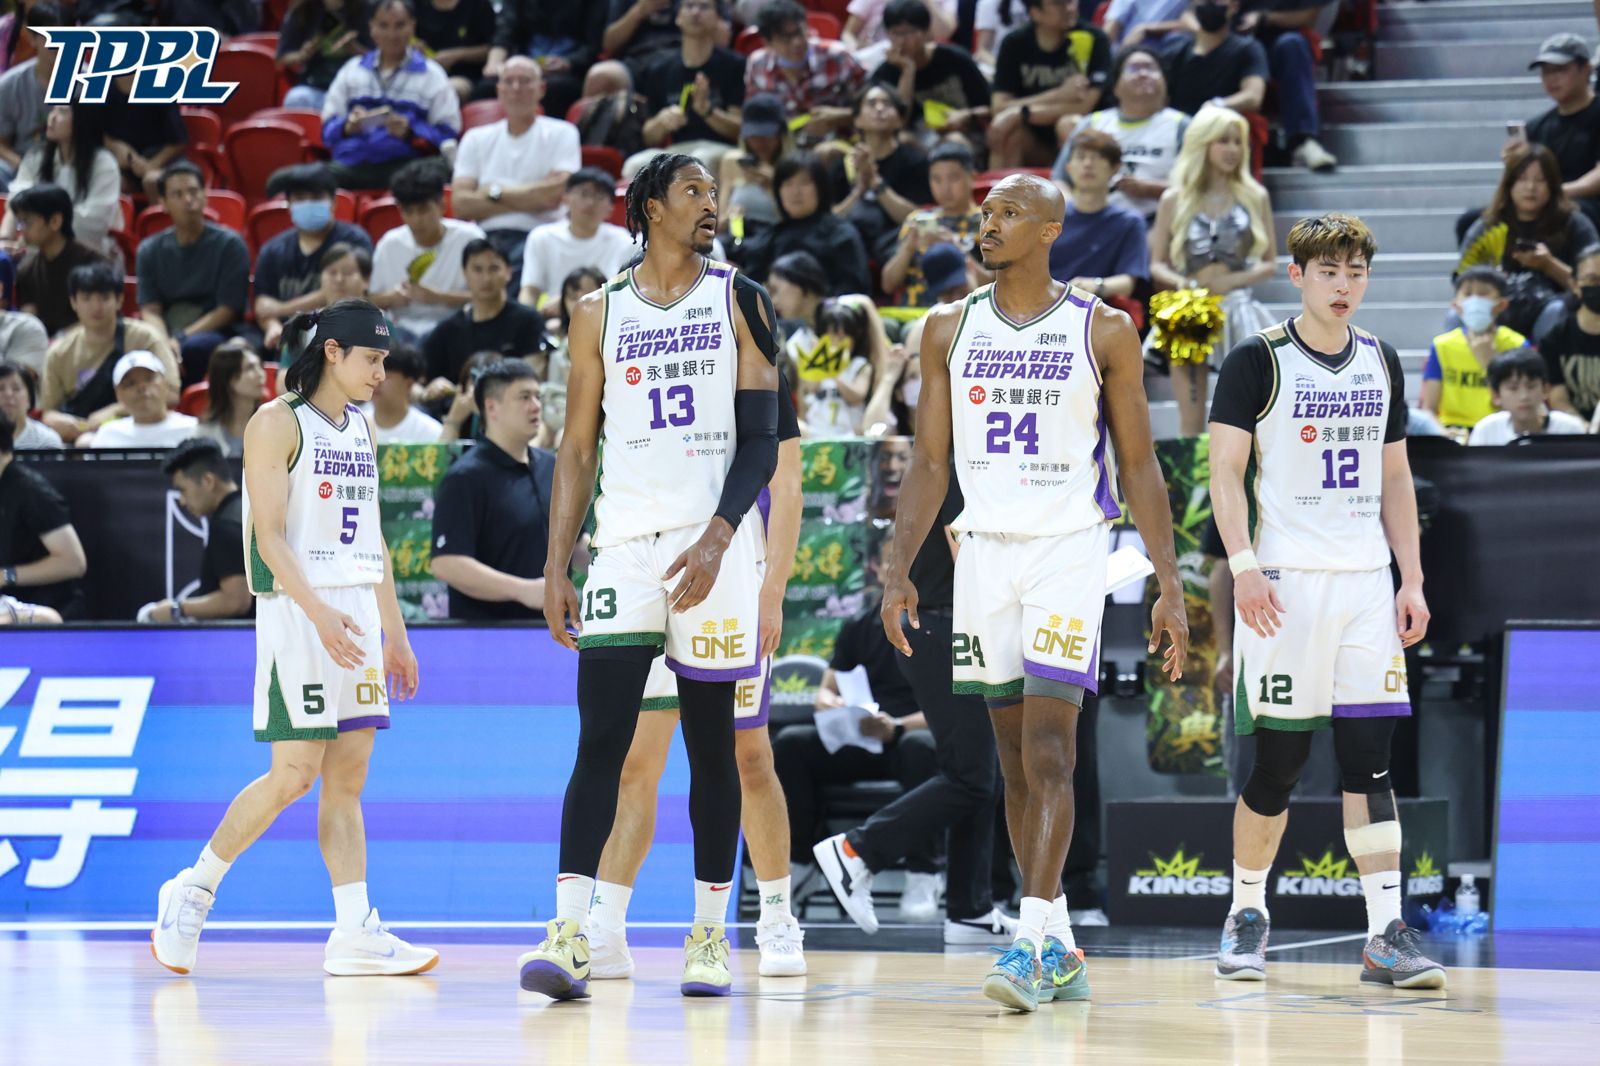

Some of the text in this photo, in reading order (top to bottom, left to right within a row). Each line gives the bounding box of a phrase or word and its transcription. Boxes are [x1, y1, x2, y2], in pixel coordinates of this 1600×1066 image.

[618, 321, 721, 345] TAIWAN BEER
[616, 334, 722, 363] LEOPARDS
[967, 350, 1074, 363] TAIWAN BEER
[647, 360, 716, 381] 永豐銀行
[962, 363, 1072, 381] LEOPARDS
[648, 384, 696, 430] 13
[992, 388, 1061, 406] 永豐銀行
[1295, 390, 1383, 402] TAIWAN BEER
[1292, 402, 1384, 418] LEOPARDS
[986, 411, 1039, 455] 24
[1321, 426, 1379, 442] 永豐銀行
[313, 448, 352, 462] TAIWAN
[1321, 449, 1359, 489] 12
[336, 485, 375, 501] 永豐銀行
[340, 507, 360, 545] 5
[585, 588, 617, 621] 13
[702, 618, 738, 635] 金牌
[1047, 613, 1085, 633] 金牌
[692, 633, 746, 659] ONE
[953, 632, 986, 668] 24
[1033, 627, 1088, 661] ONE
[356, 683, 388, 705] ON
[1259, 674, 1293, 705] 12
[1384, 670, 1408, 694] ON
[303, 683, 325, 715] 5
[735, 684, 756, 708] NE
[1128, 876, 1233, 897] KINGS
